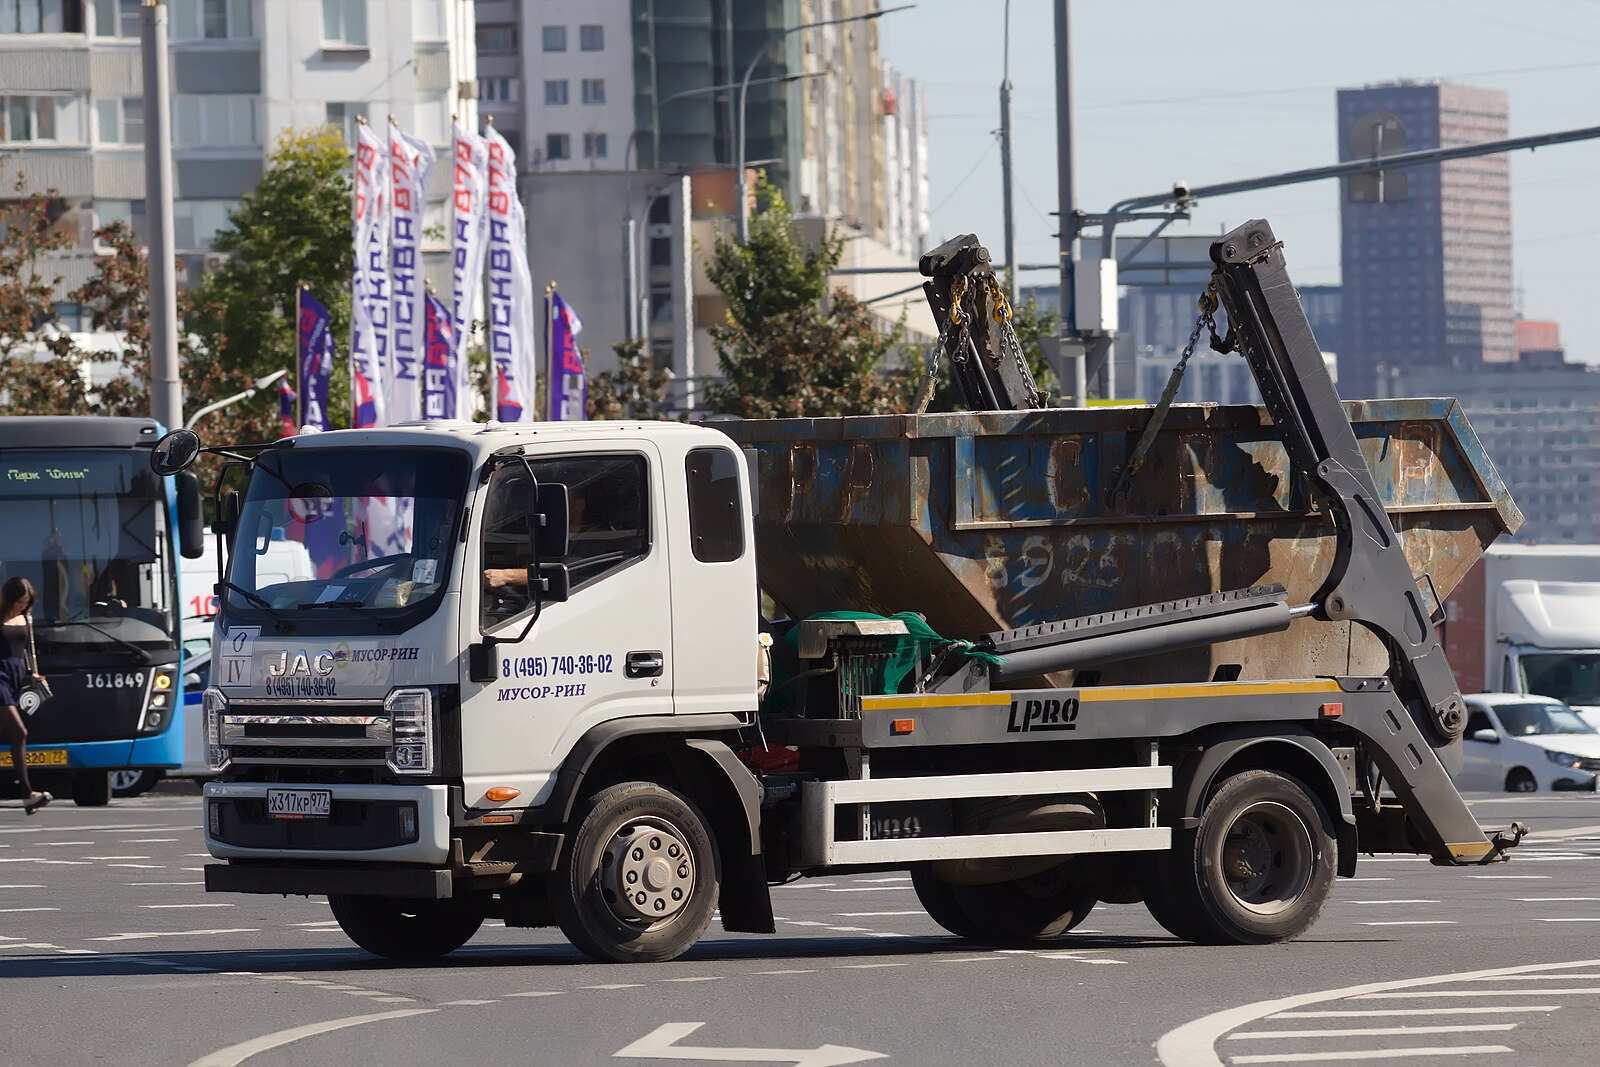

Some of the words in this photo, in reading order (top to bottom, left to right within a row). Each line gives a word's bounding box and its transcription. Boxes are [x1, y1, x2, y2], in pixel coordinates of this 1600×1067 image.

[489, 219, 513, 381] МОСКВА
[269, 650, 335, 677] JAC
[351, 647, 420, 663] МУСОР-РИН
[502, 658, 511, 678] 8
[514, 656, 548, 679] (495)
[551, 653, 613, 676] 740-36-02
[86, 672, 144, 688] 161849
[227, 659, 246, 683] IV
[266, 680, 273, 697] 8
[273, 677, 295, 697] (495)
[296, 677, 338, 697] 740-36-02
[497, 684, 587, 702] МУСОР-РИН
[1007, 697, 1080, 733] LPRO
[311, 792, 328, 808] 977
